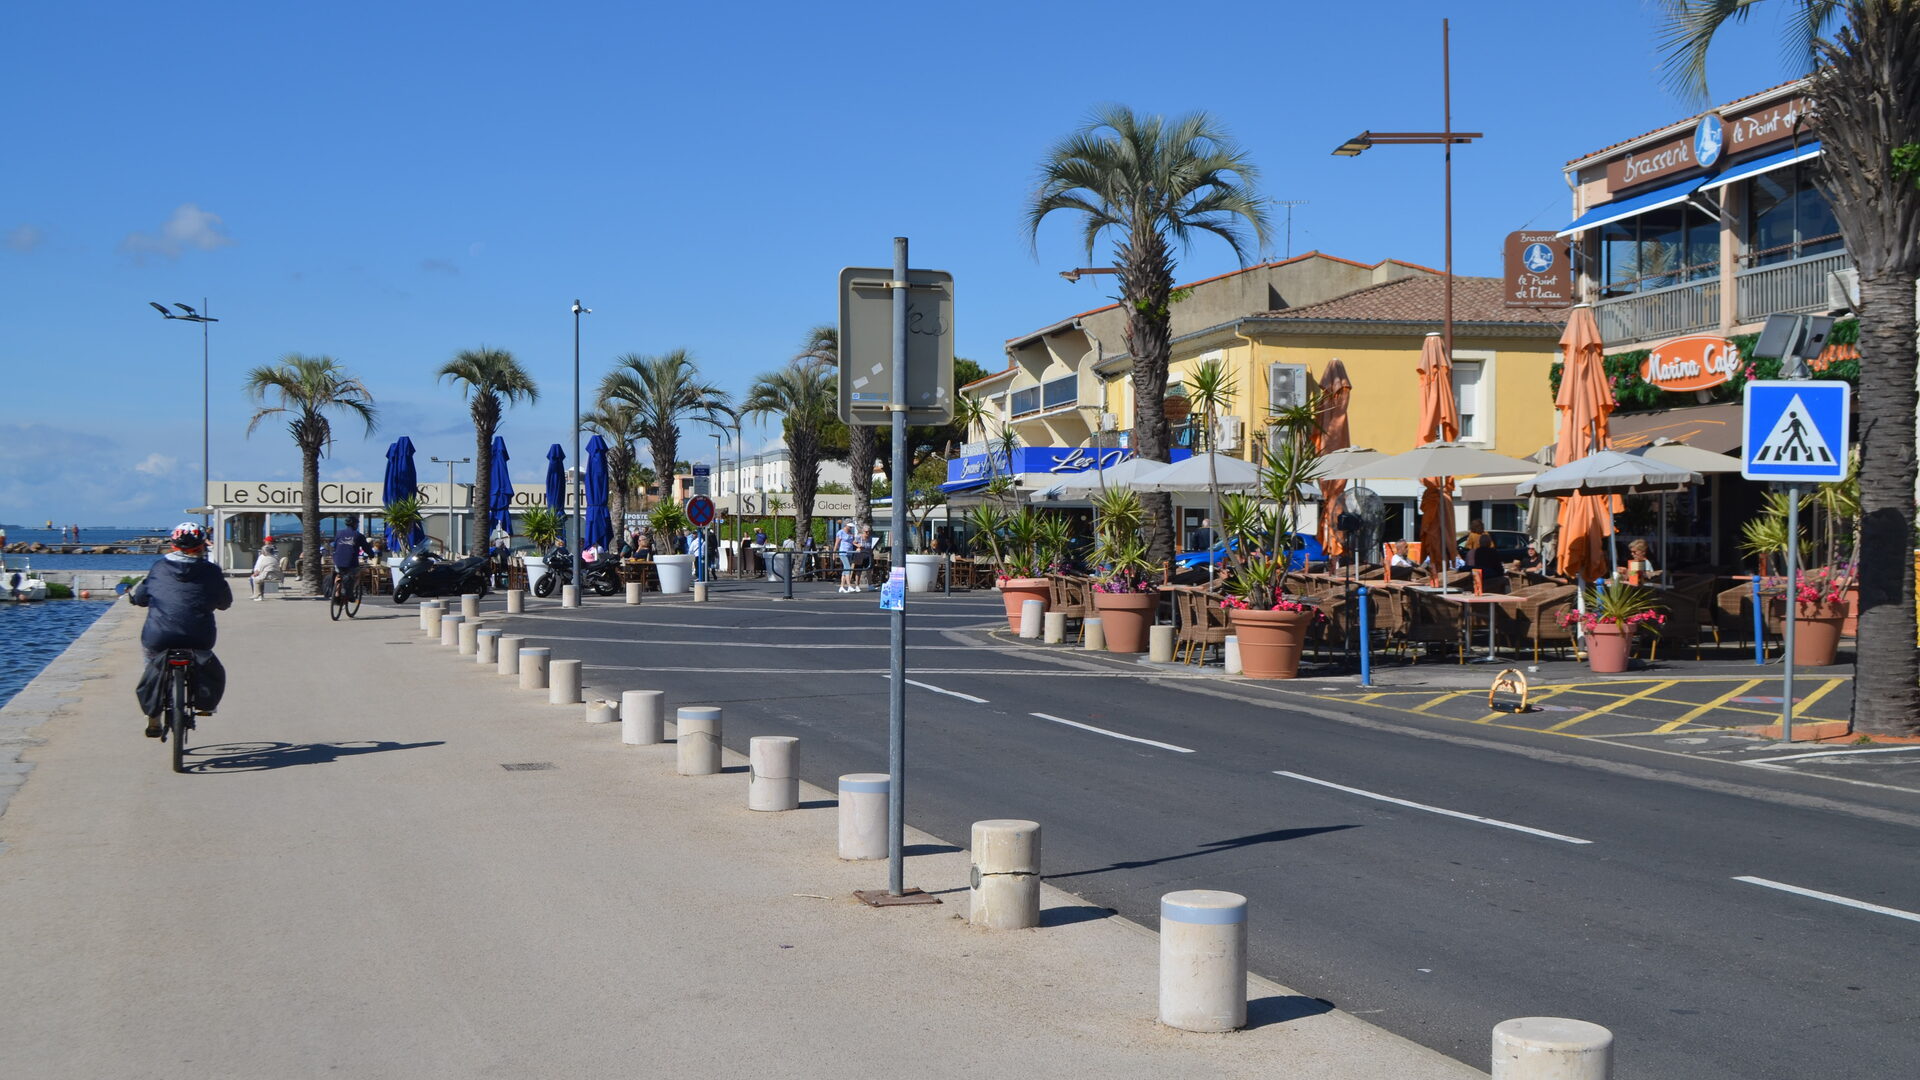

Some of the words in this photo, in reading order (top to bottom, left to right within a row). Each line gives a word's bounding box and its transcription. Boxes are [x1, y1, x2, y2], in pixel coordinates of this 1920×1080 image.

[1623, 139, 1690, 184] Brasserie
[1743, 109, 1780, 139] Point
[1527, 273, 1558, 286] Point
[1515, 286, 1528, 299] de
[1644, 352, 1700, 384] Marina
[1703, 343, 1741, 382] Café
[1050, 448, 1096, 473] Les
[224, 483, 249, 504] Le
[256, 483, 304, 504] Sain
[321, 483, 373, 504] Clair
[818, 500, 852, 511] Glacier
